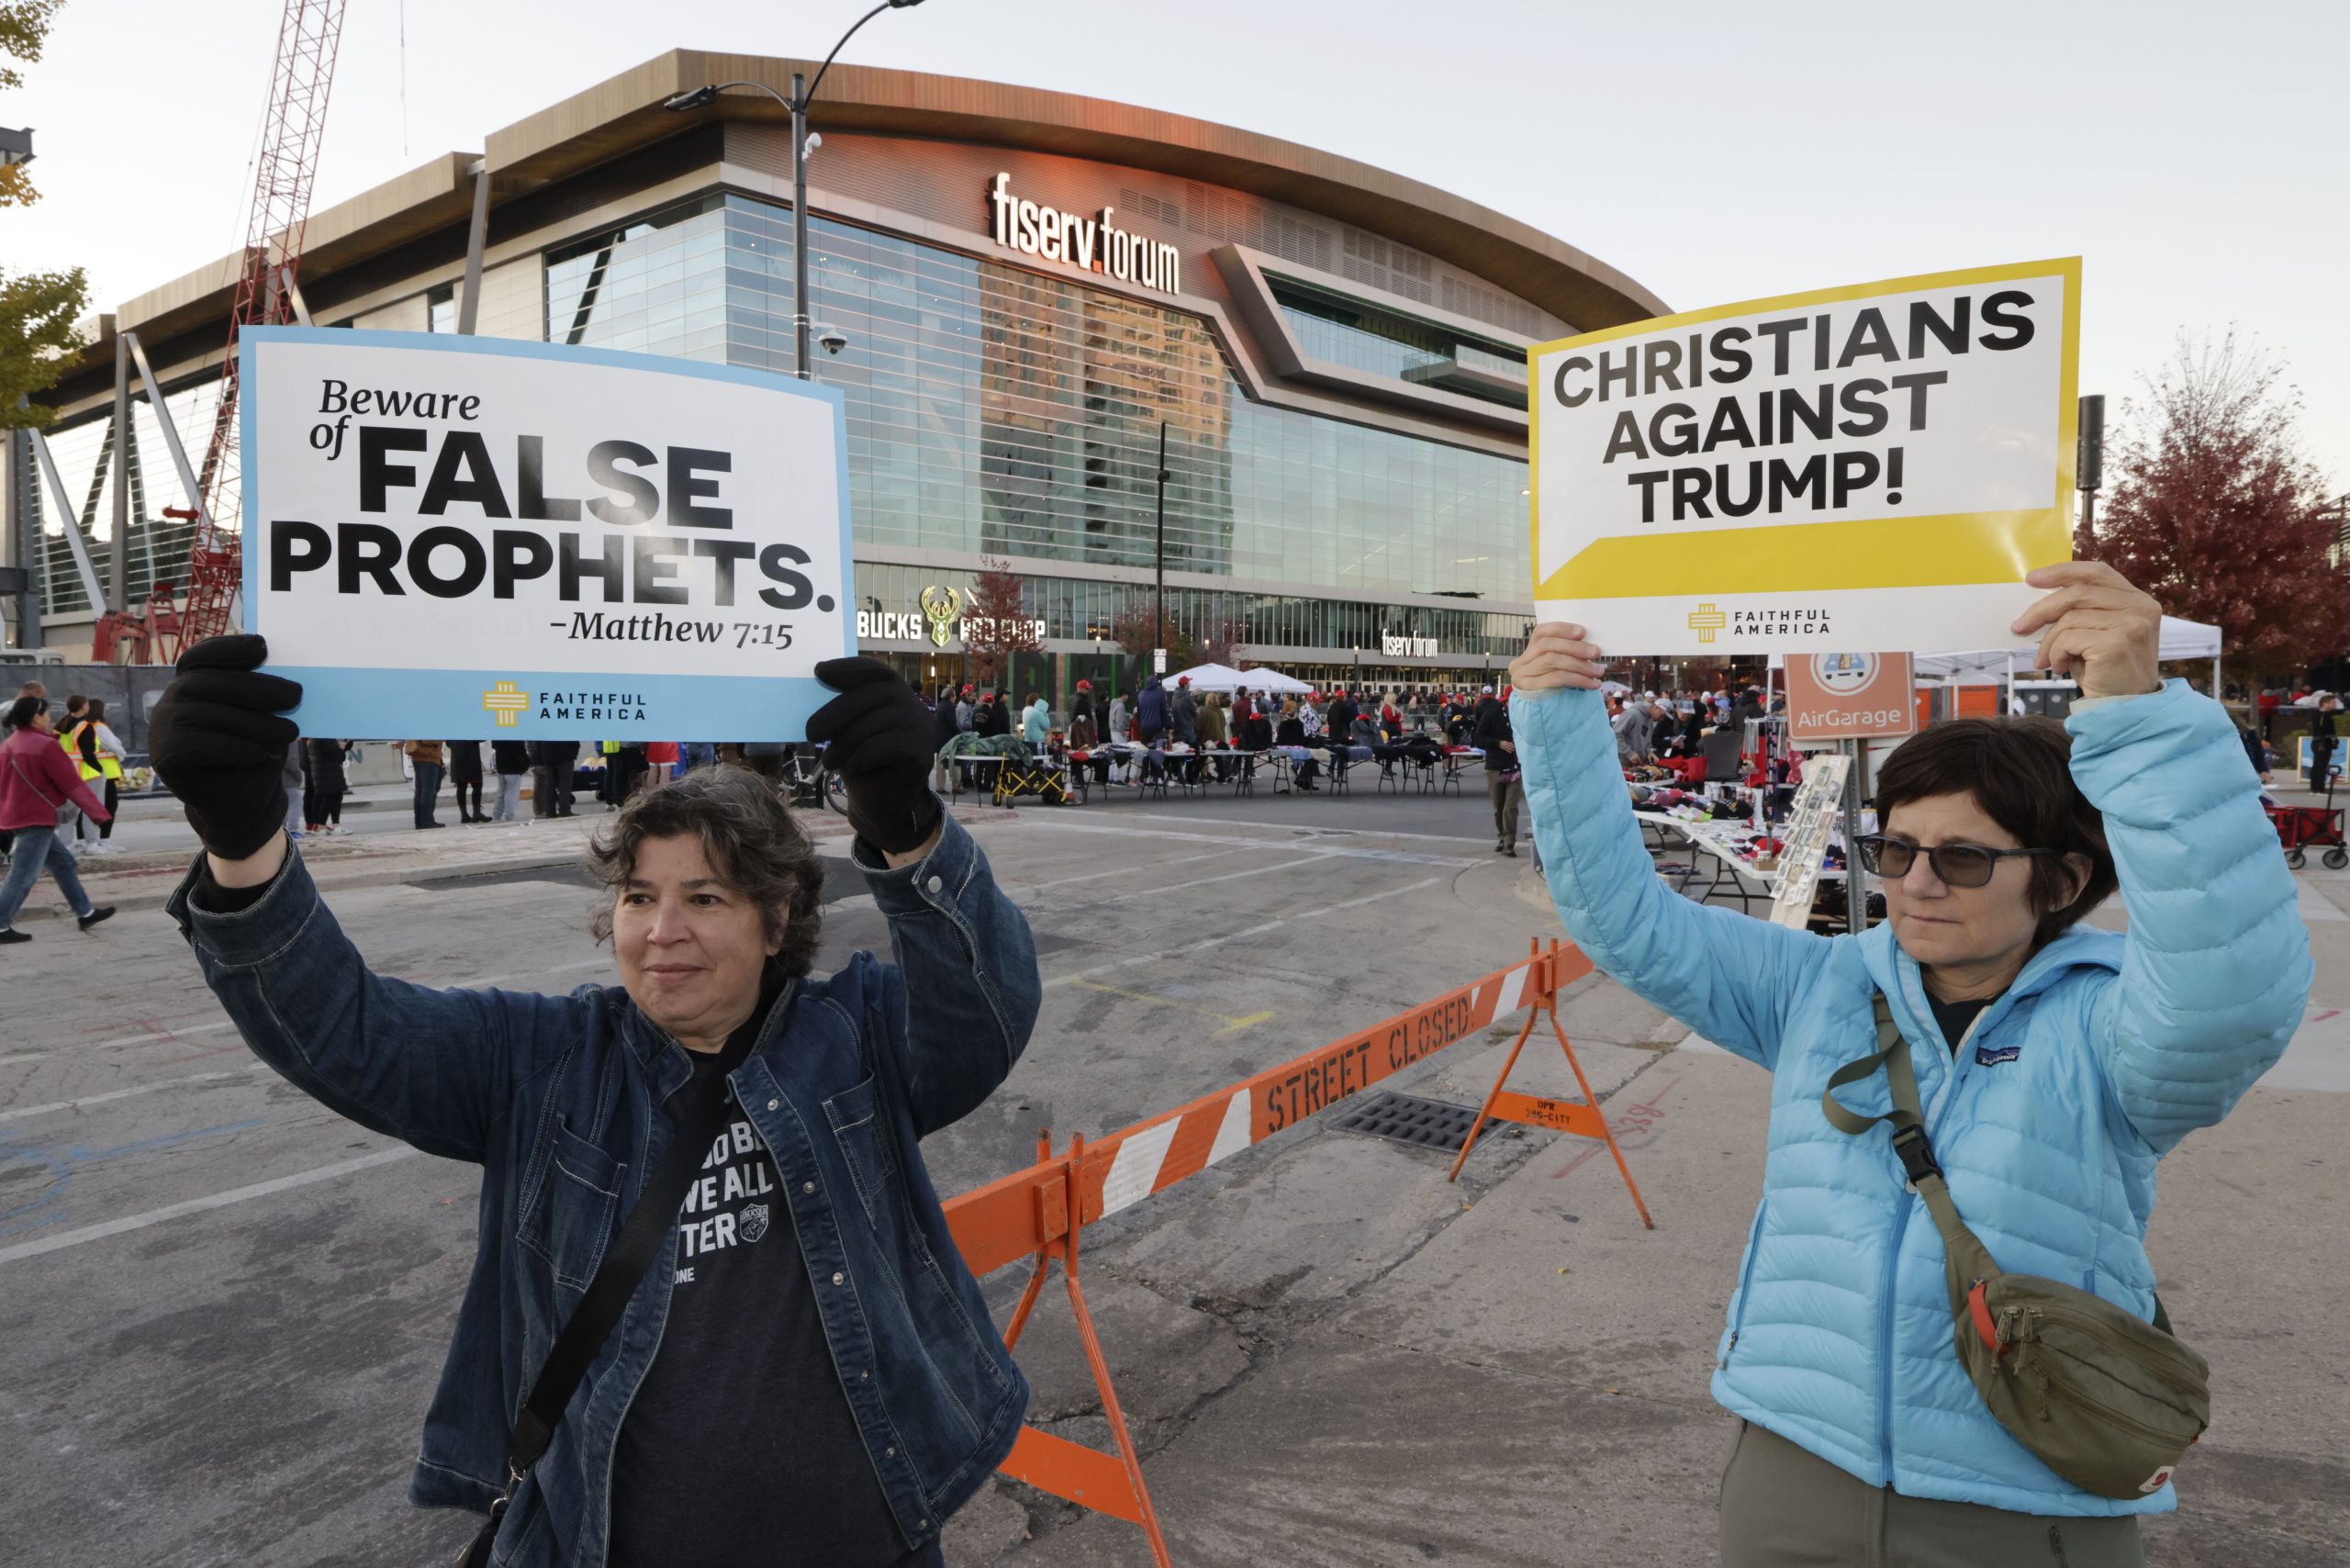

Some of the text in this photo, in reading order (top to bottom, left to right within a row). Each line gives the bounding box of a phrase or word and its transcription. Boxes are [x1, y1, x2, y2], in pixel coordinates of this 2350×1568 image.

[1553, 290, 2035, 409] CHRISTIANS
[319, 378, 481, 420] Beware
[1602, 370, 1948, 465] AGAINST
[309, 415, 353, 461] of
[359, 425, 733, 531] FALSE
[1628, 446, 1904, 523] TRUMP!
[270, 520, 836, 613] PROPHETS.
[733, 622, 794, 650] 7:15
[856, 610, 922, 640] BUCKS
[1733, 622, 1830, 635] AMERICA
[1734, 609, 1831, 622] FAITHFUL
[539, 691, 646, 706] FAITHFUL
[539, 707, 645, 721] AMERICA
[1797, 709, 1902, 728] AirGarage
[1268, 996, 1469, 1134] STREET CLOSED
[1538, 1100, 1555, 1111] DPW
[723, 1161, 773, 1203] ALL
